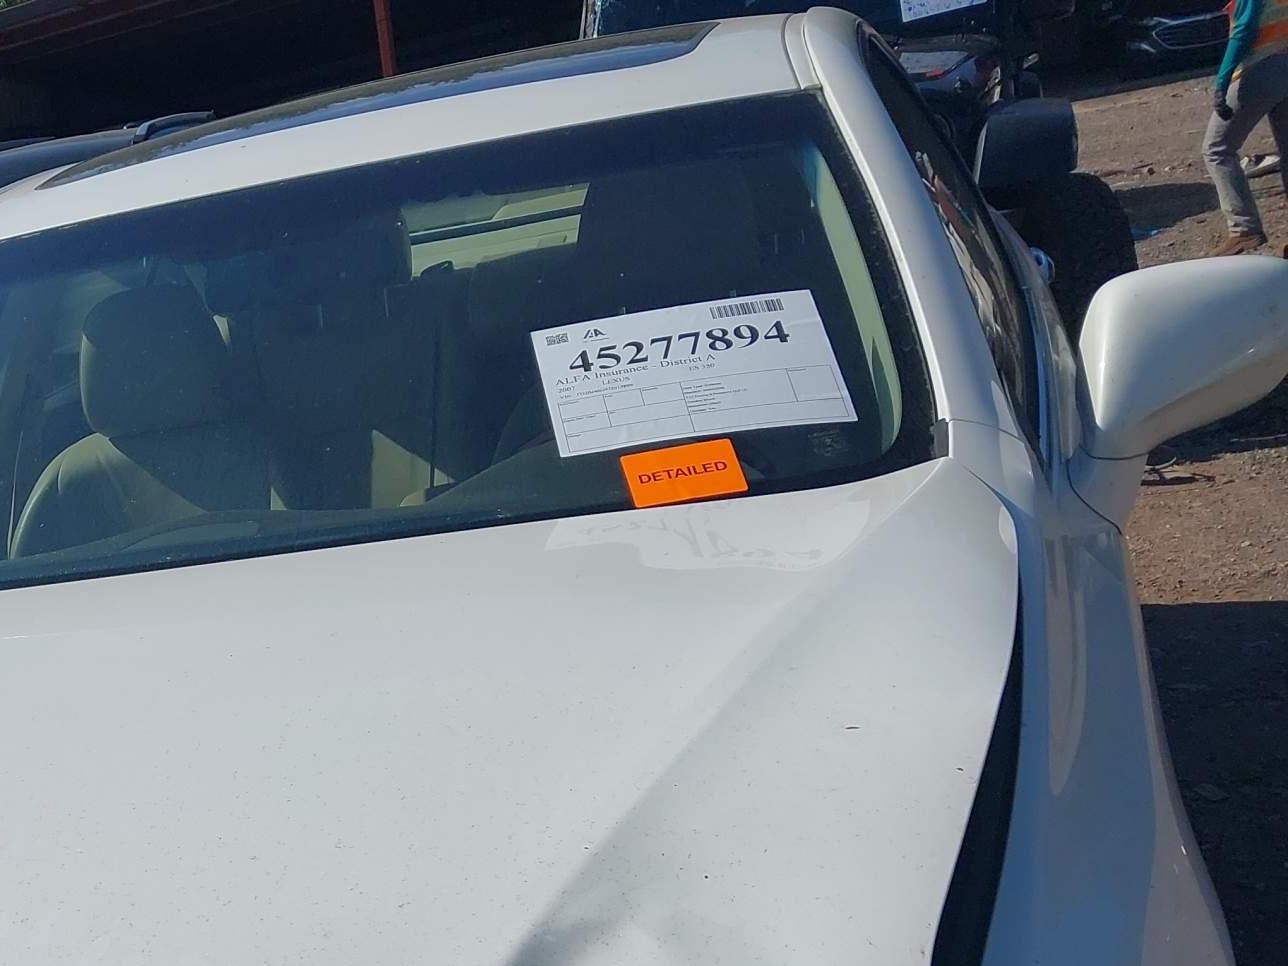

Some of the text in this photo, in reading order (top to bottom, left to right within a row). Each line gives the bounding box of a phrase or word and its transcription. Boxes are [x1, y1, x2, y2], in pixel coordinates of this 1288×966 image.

[568, 319, 791, 373] 45277894
[555, 374, 591, 386] ALFA
[595, 365, 649, 379] Insurance
[660, 356, 702, 369] District
[705, 354, 716, 362] A
[602, 376, 631, 386] LEXUS
[638, 460, 727, 485] DETAILED
